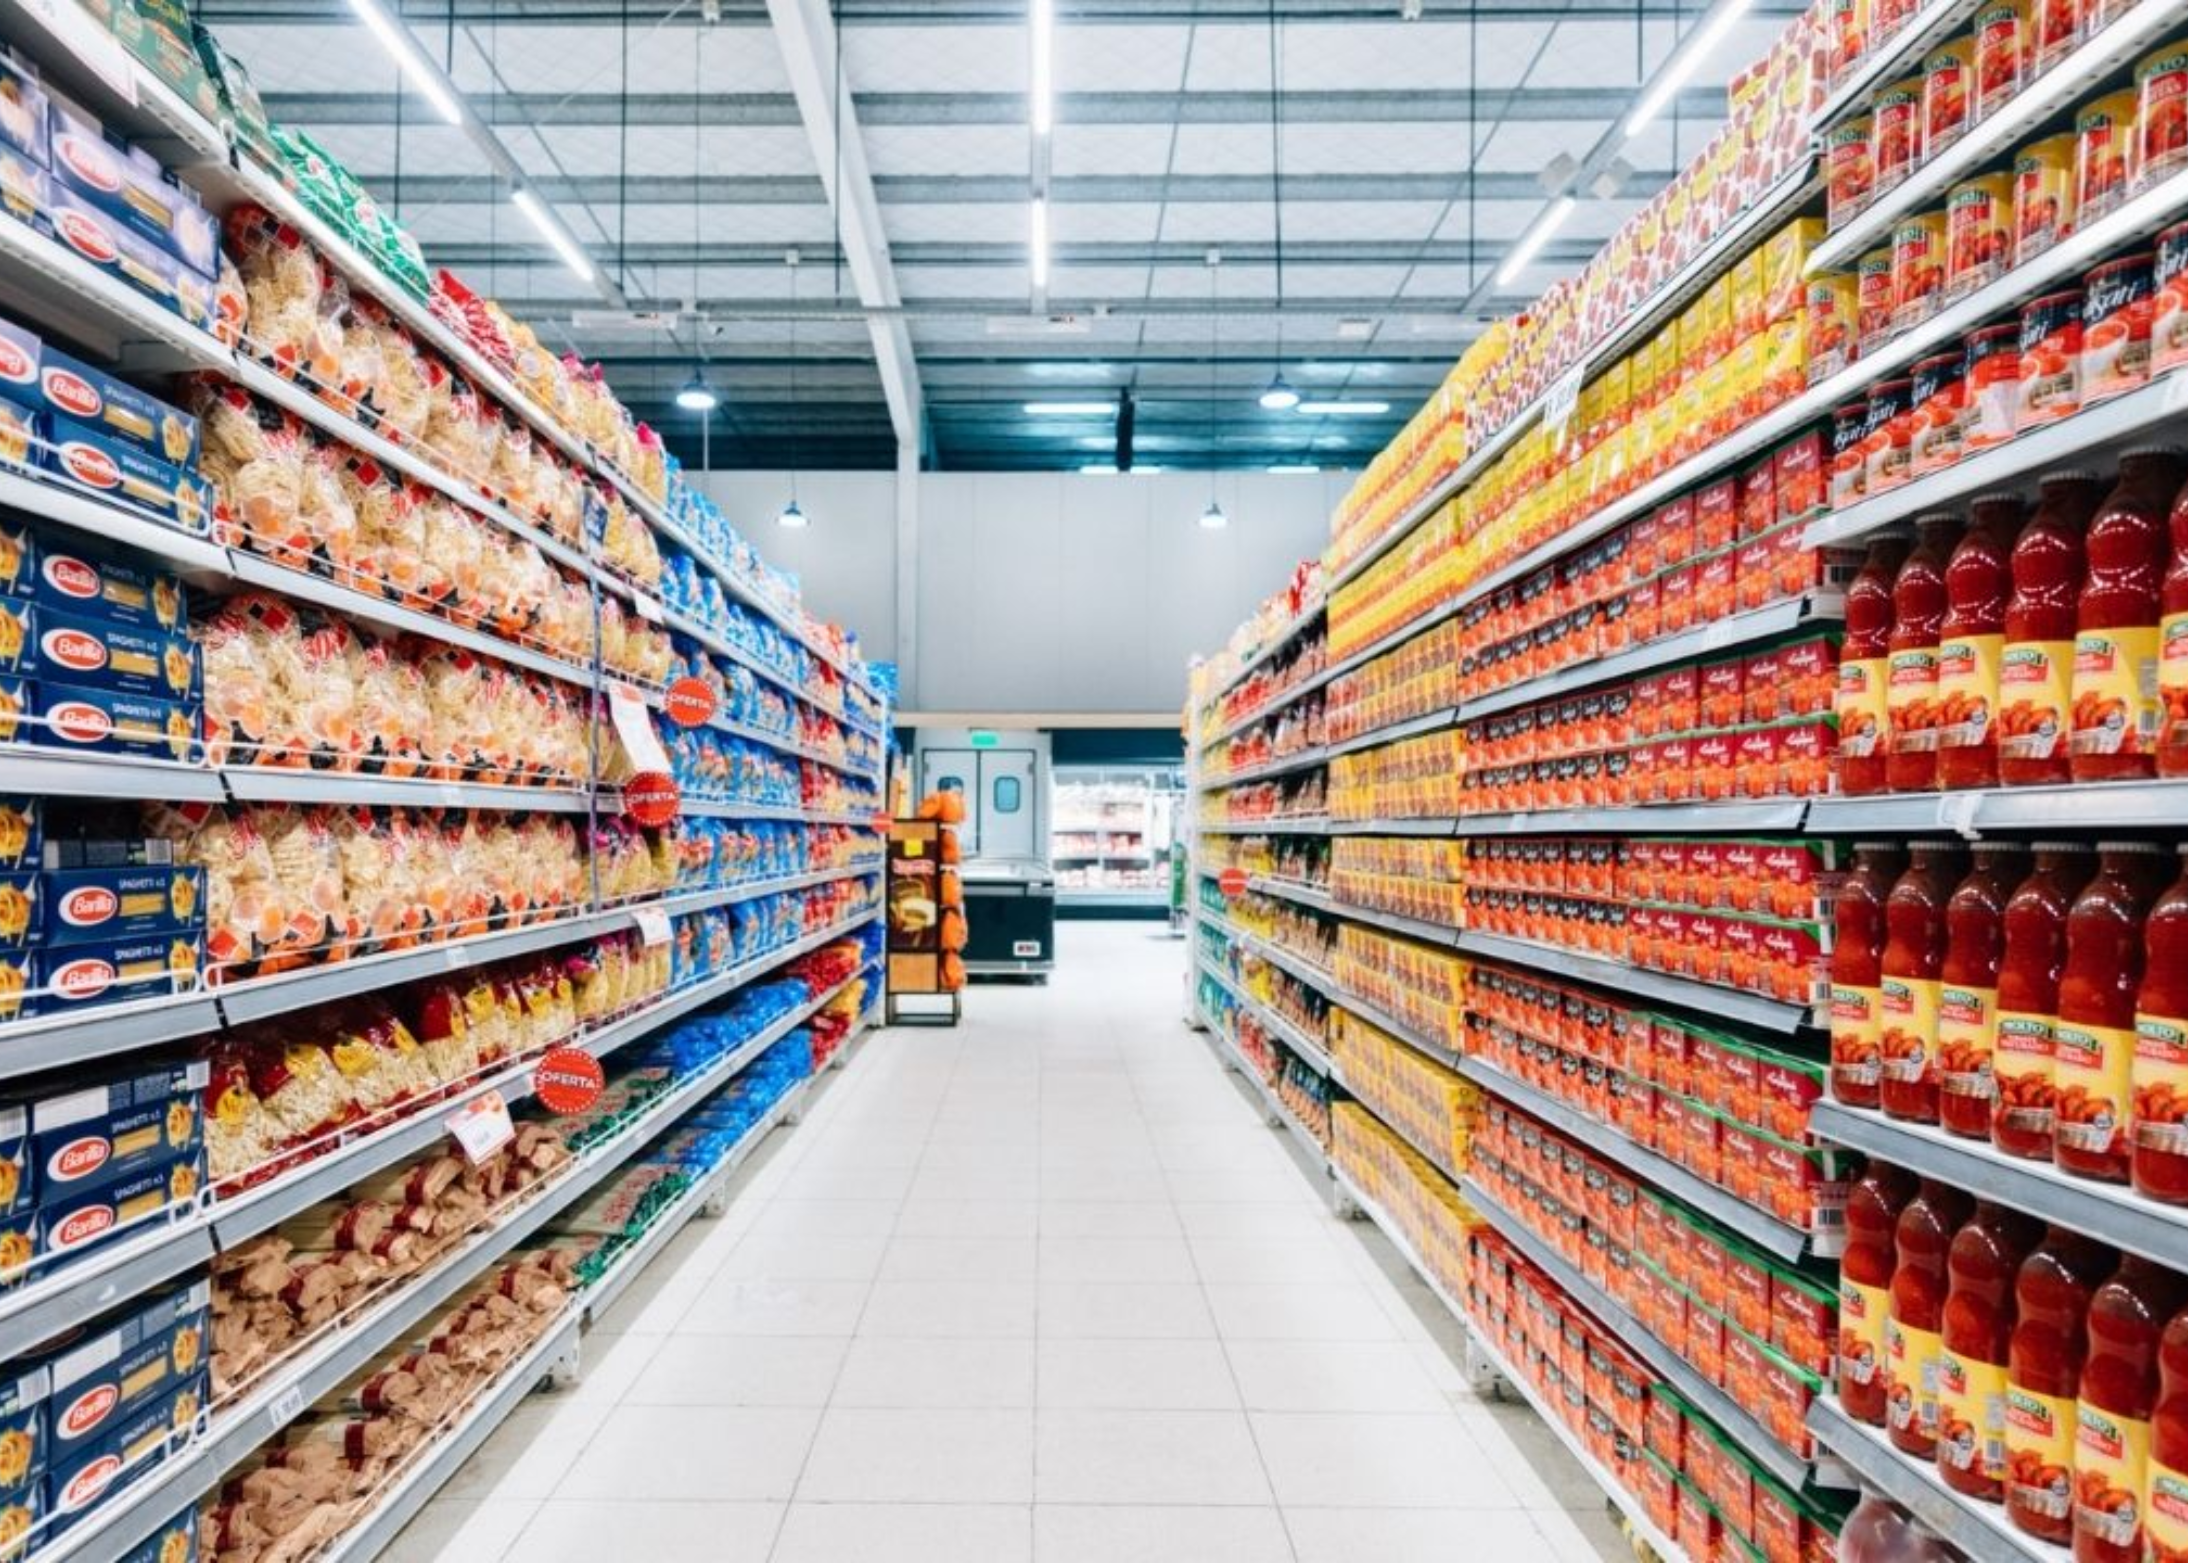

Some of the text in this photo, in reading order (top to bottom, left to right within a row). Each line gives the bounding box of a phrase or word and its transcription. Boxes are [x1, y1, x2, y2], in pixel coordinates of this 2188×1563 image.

[52, 377, 97, 409] Barilla
[57, 564, 99, 590] Barilla
[58, 639, 103, 662] Barilla
[671, 694, 711, 709] OFERTA
[631, 792, 675, 804] OFERTA
[118, 877, 154, 890] SPAGHETTI
[72, 895, 113, 918] Barilla
[541, 1071, 596, 1089] OFERTA
[62, 1145, 106, 1173] Barilla
[63, 1211, 108, 1242] Barilla
[74, 1388, 116, 1426] Barilla
